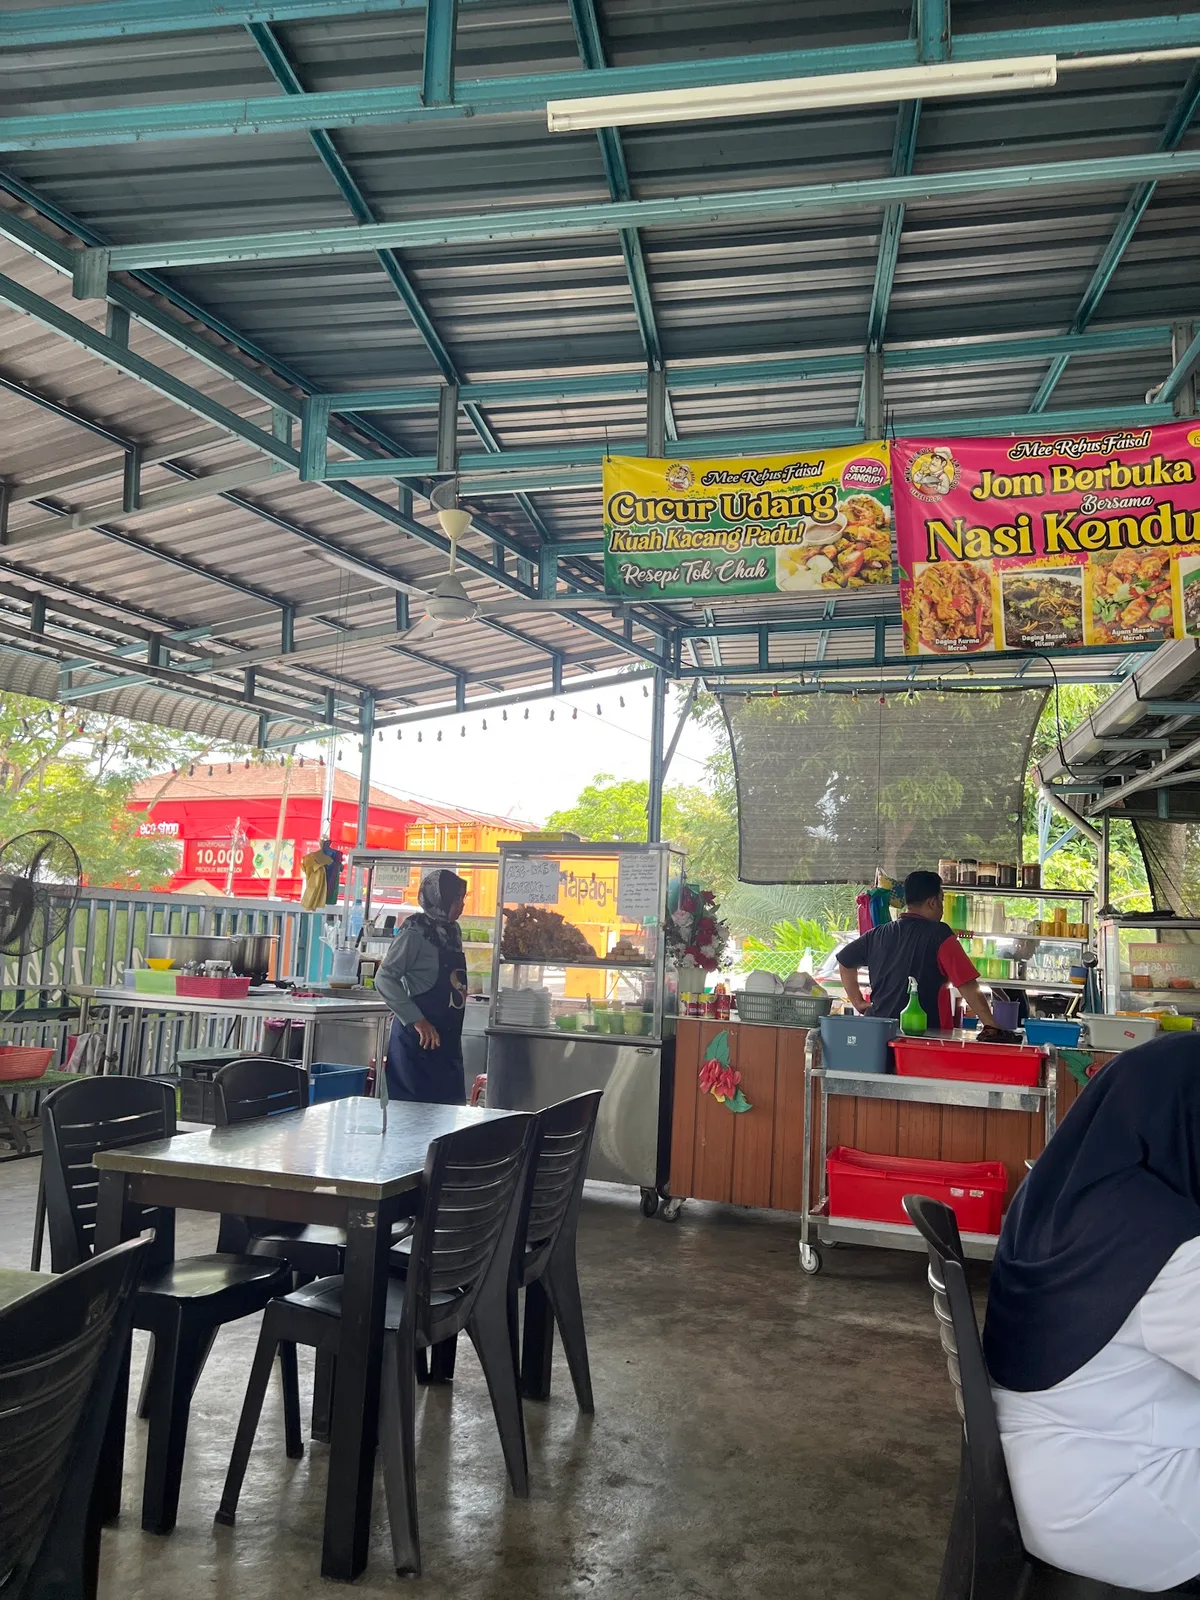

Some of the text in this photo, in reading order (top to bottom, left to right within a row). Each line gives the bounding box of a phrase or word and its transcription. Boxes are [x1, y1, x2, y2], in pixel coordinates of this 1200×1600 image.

[1009, 430, 1152, 460] Mee Rebus Faisol
[702, 469, 740, 487] Mee
[743, 468, 783, 486] Rebus
[782, 460, 825, 482] Faisol
[850, 465, 882, 476] SEDAP!
[970, 455, 1195, 501] Jom Berbuka
[607, 485, 840, 527] Cucur Udang
[1081, 494, 1154, 515] Bersama
[609, 521, 806, 554] Kuah Kacang Padu!
[925, 512, 1035, 562] Nasi
[619, 558, 769, 590] Resepi Tok Chah
[935, 636, 980, 646] Daging Kurma
[1022, 632, 1067, 642] Daging Masak
[1112, 626, 1155, 637] Ayam Masak
[1122, 634, 1144, 642] Merah
[947, 644, 967, 652] Merah
[1034, 639, 1055, 648] Hitam
